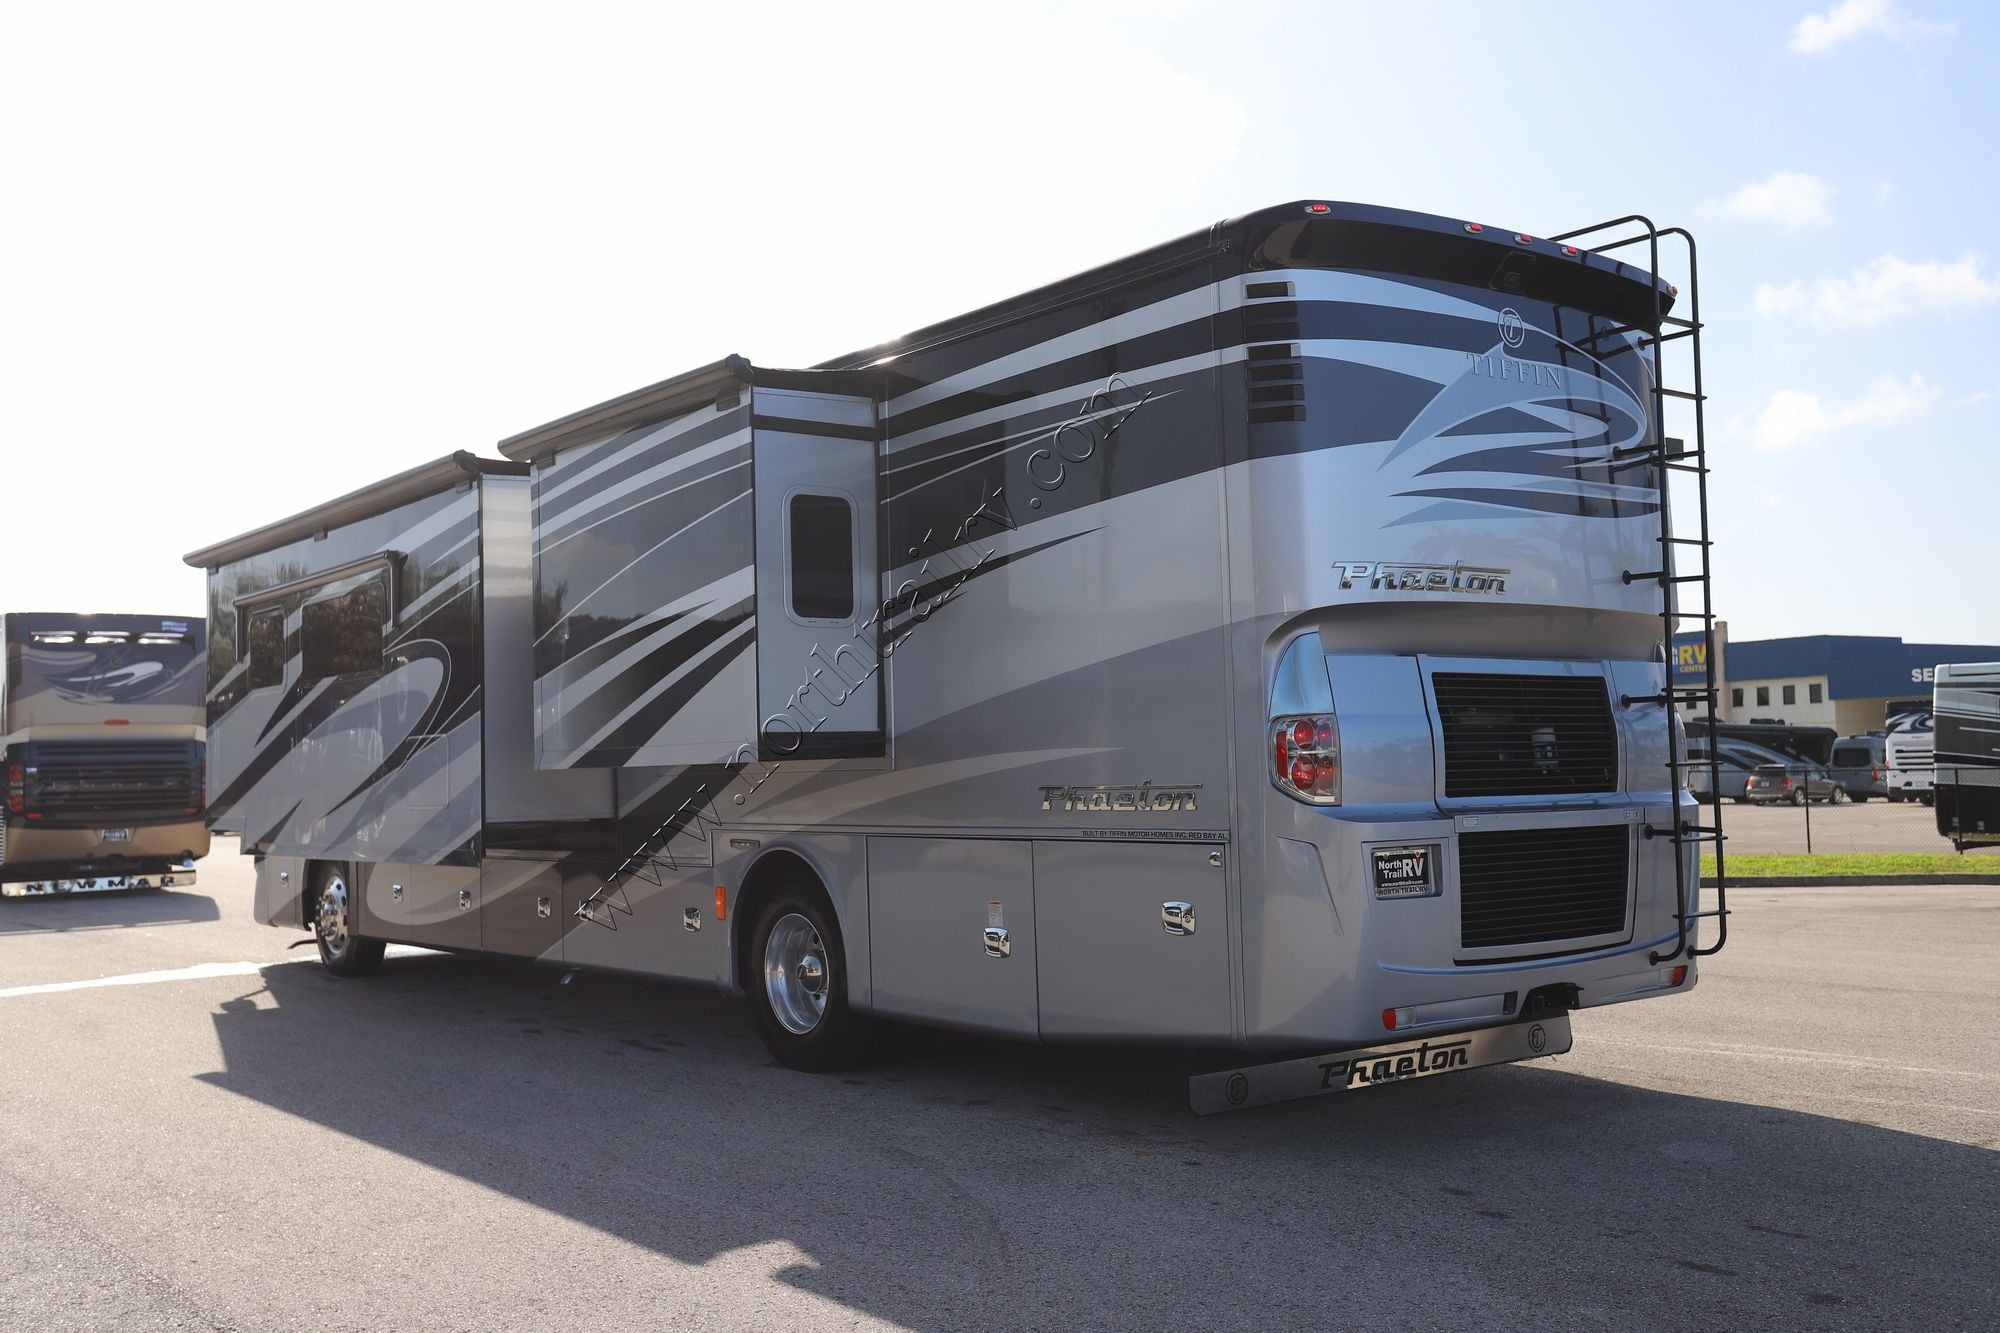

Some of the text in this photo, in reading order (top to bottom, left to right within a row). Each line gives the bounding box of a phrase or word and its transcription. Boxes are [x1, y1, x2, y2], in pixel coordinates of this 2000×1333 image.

[1466, 352, 1561, 392] TIFFIN
[1331, 560, 1511, 596] Phaeton
[1679, 643, 1707, 665] RV
[1039, 780, 1202, 811] Phaeton
[1378, 860, 1402, 870] North
[1383, 869, 1402, 879] Trail
[1402, 858, 1424, 878] RV
[1318, 1040, 1472, 1090] Phaeton
